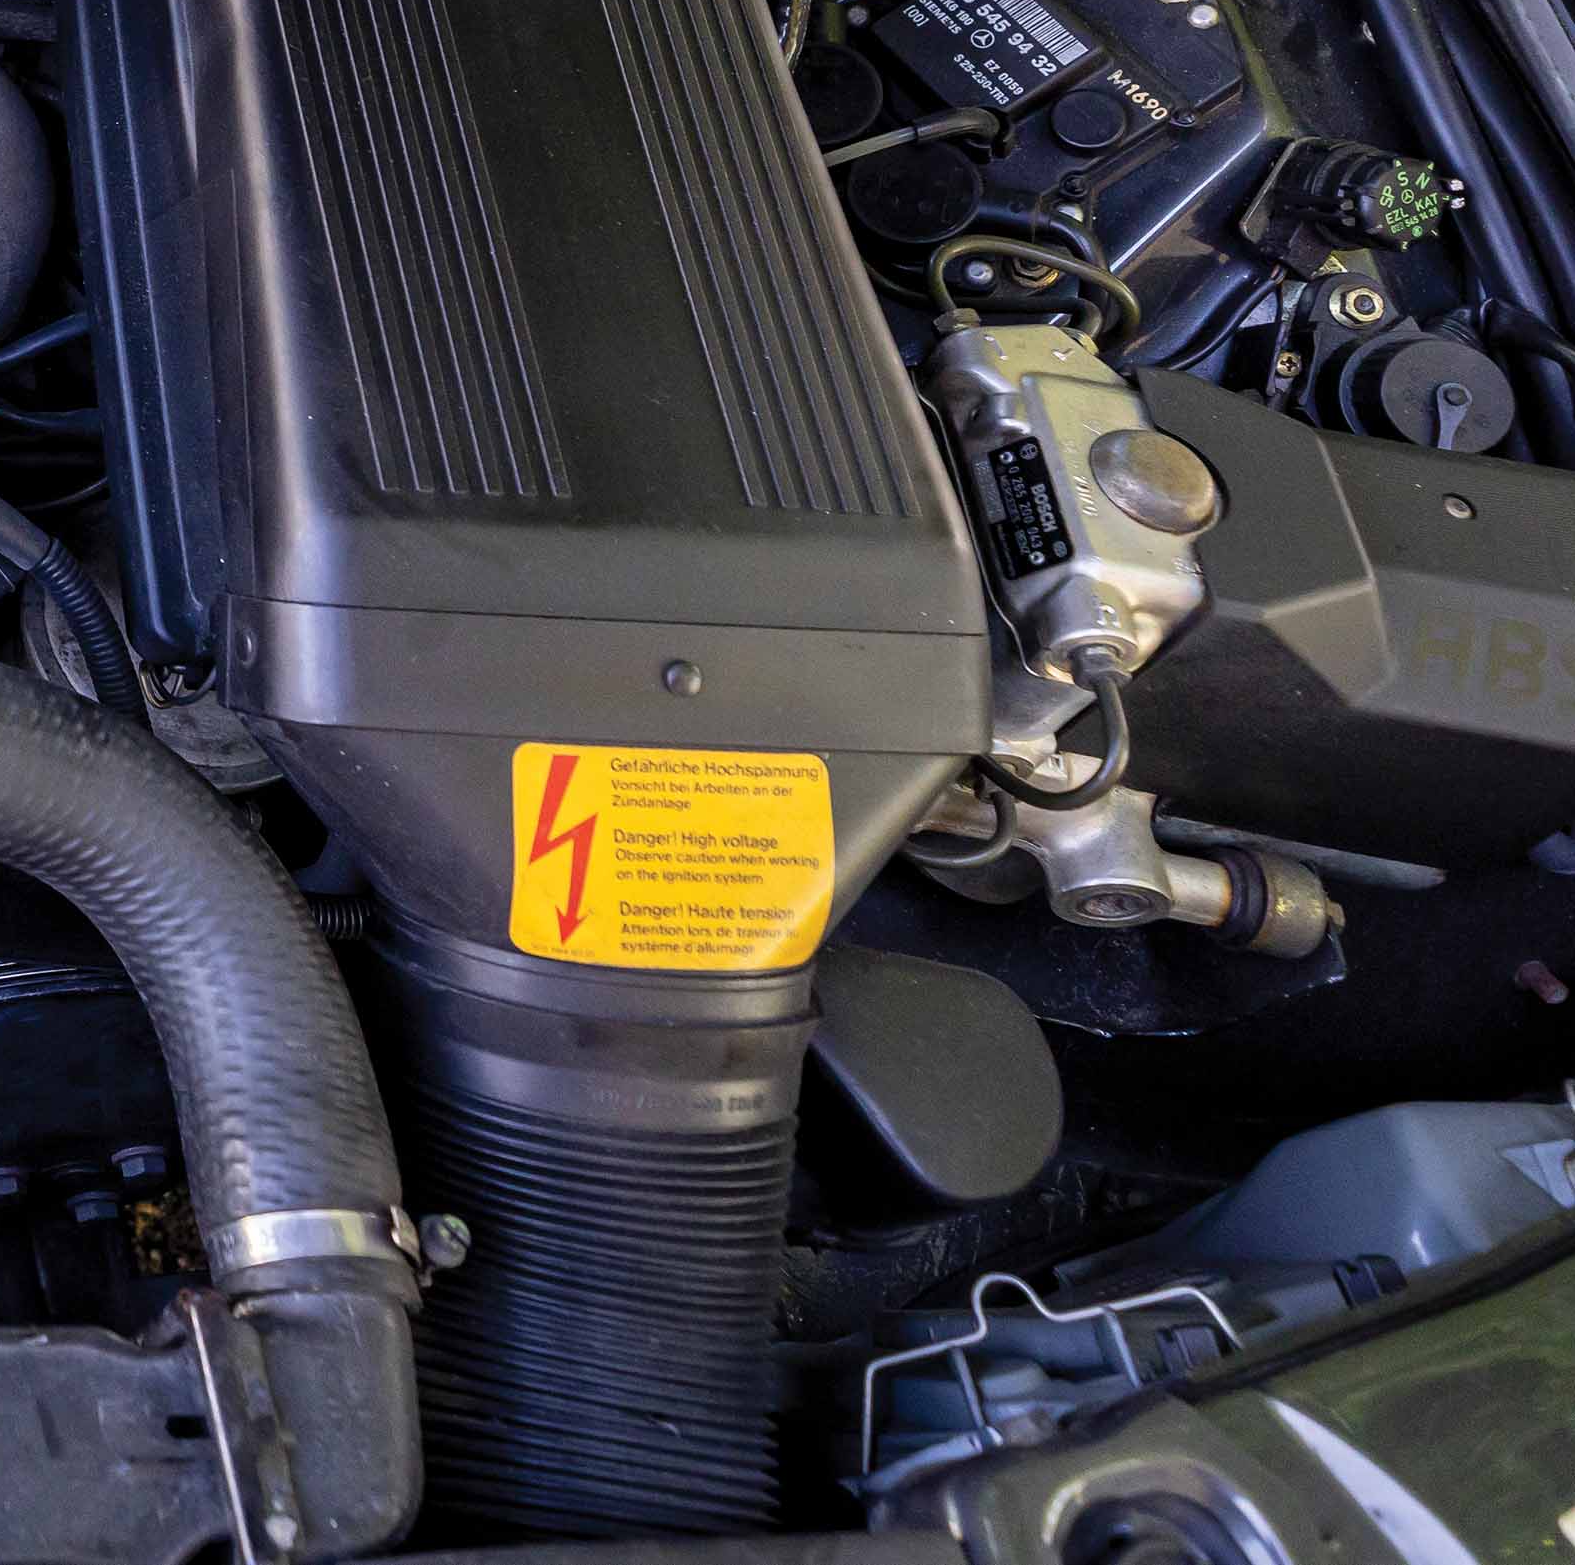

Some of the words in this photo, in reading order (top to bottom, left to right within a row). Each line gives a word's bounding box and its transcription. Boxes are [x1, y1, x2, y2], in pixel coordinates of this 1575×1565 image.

[976, 3, 1011, 32] 545
[1008, 32, 1034, 54] 94
[1031, 54, 1057, 76] 32
[983, 59, 1000, 73] EZ
[1397, 171, 1408, 186] S
[1385, 207, 1409, 225] EZL
[1414, 192, 1438, 212] KAT
[1031, 483, 1058, 533] BOSCH
[611, 779, 666, 792] Vorsicht
[669, 782, 689, 793] bei
[694, 783, 749, 796] Arbeiten
[753, 786, 769, 796] an
[772, 785, 792, 796] der
[613, 829, 676, 848] Danger!
[682, 833, 717, 849] High
[722, 836, 778, 852] voltage
[615, 849, 672, 862] Observe
[676, 852, 725, 864] caution
[729, 854, 765, 866] when
[769, 856, 820, 870] working
[616, 871, 633, 881] on
[637, 869, 659, 882] the
[662, 870, 711, 885] ignition
[714, 873, 764, 886] system
[619, 901, 684, 920] Danger!
[688, 904, 735, 920] Haute
[740, 906, 796, 921] tension
[622, 923, 684, 937] Attention
[688, 924, 712, 937] lors
[716, 926, 732, 938] de
